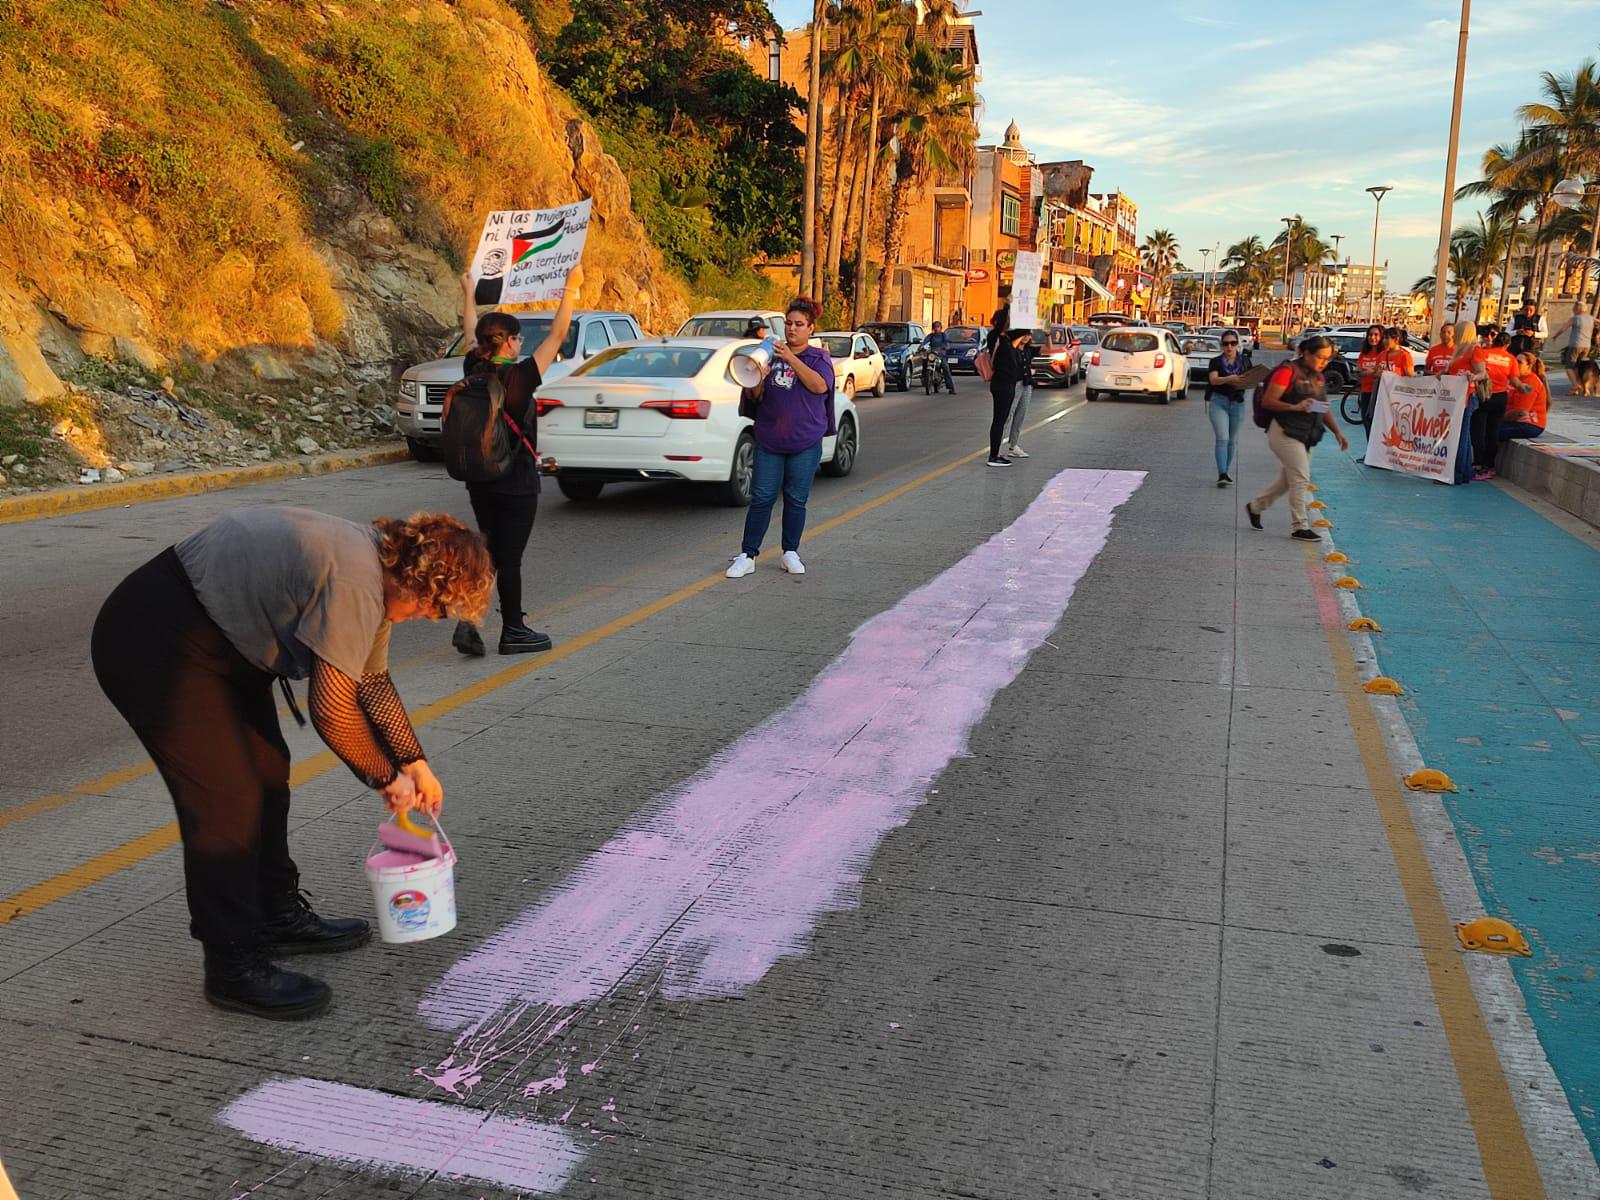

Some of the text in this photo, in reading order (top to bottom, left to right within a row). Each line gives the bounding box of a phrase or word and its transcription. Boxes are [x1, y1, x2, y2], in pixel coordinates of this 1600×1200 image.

[488, 206, 579, 226] Ni las mujeres
[484, 230, 499, 242] ni
[506, 227, 524, 239] los
[513, 249, 579, 272] son territorio
[509, 267, 569, 287] de conquista
